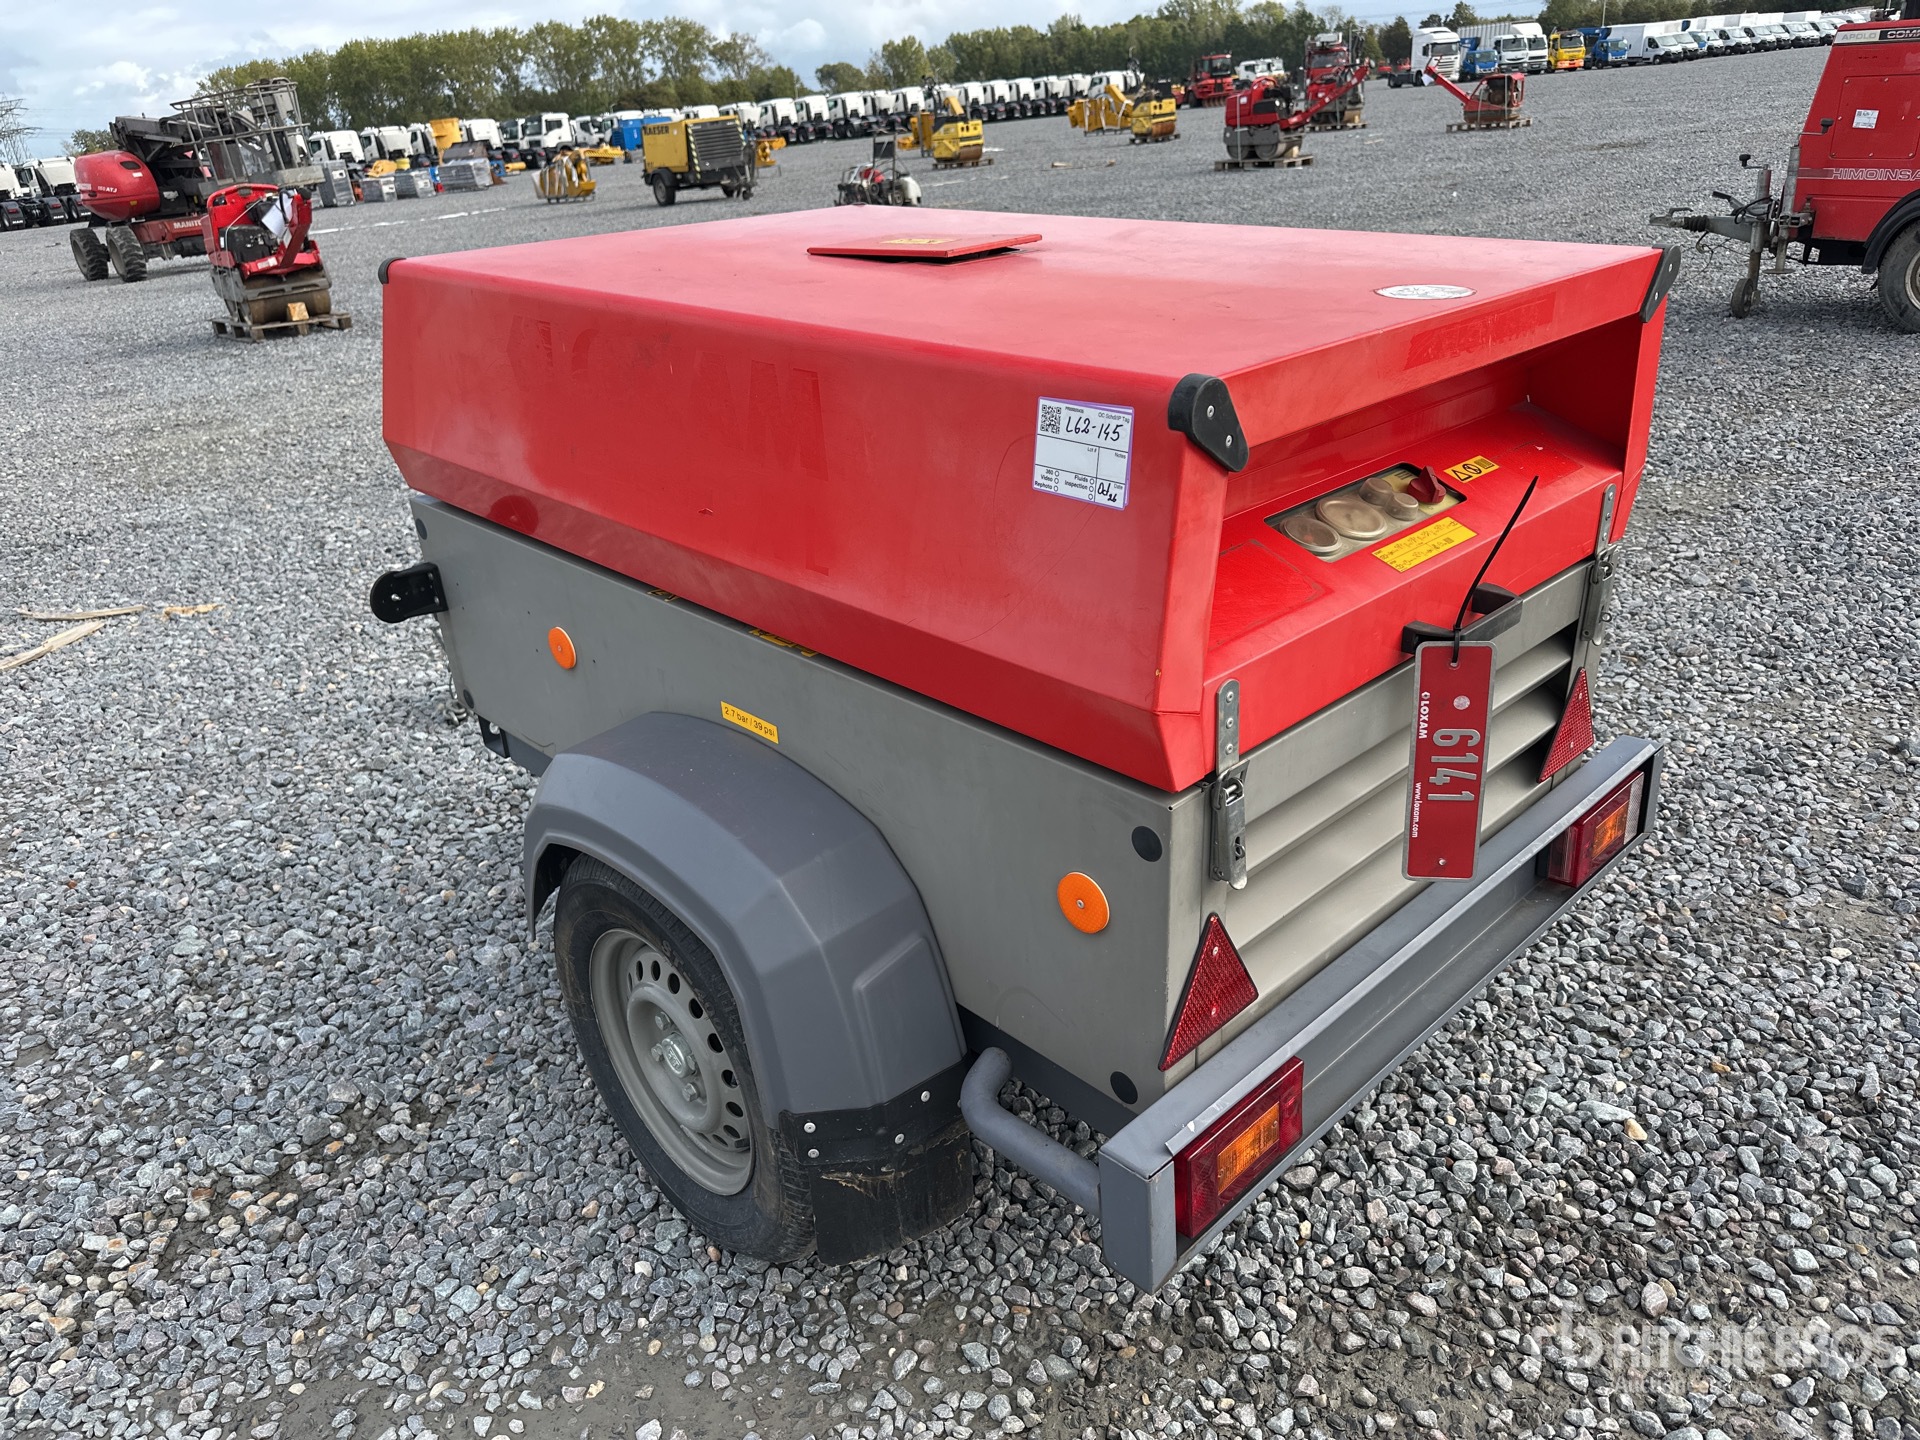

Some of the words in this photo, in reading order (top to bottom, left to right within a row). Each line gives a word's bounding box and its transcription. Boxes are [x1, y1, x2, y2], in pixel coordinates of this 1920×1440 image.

[1841, 32, 1877, 41] APOLO
[643, 125, 670, 136] KAESER
[106, 186, 118, 194] ATJ
[1122, 416, 1130, 424] Tag
[1040, 474, 1054, 482] Video
[1074, 474, 1088, 482] Fluids
[1035, 481, 1052, 489] Rephoto
[1065, 481, 1088, 489] Inspection
[725, 707, 735, 717] 2.7
[737, 712, 748, 723] bar
[754, 721, 763, 731] 39
[764, 727, 775, 737] psi
[1419, 701, 1430, 739] LOXAM
[1427, 728, 1481, 802] 6141
[1412, 783, 1423, 838] www.loxam.com
